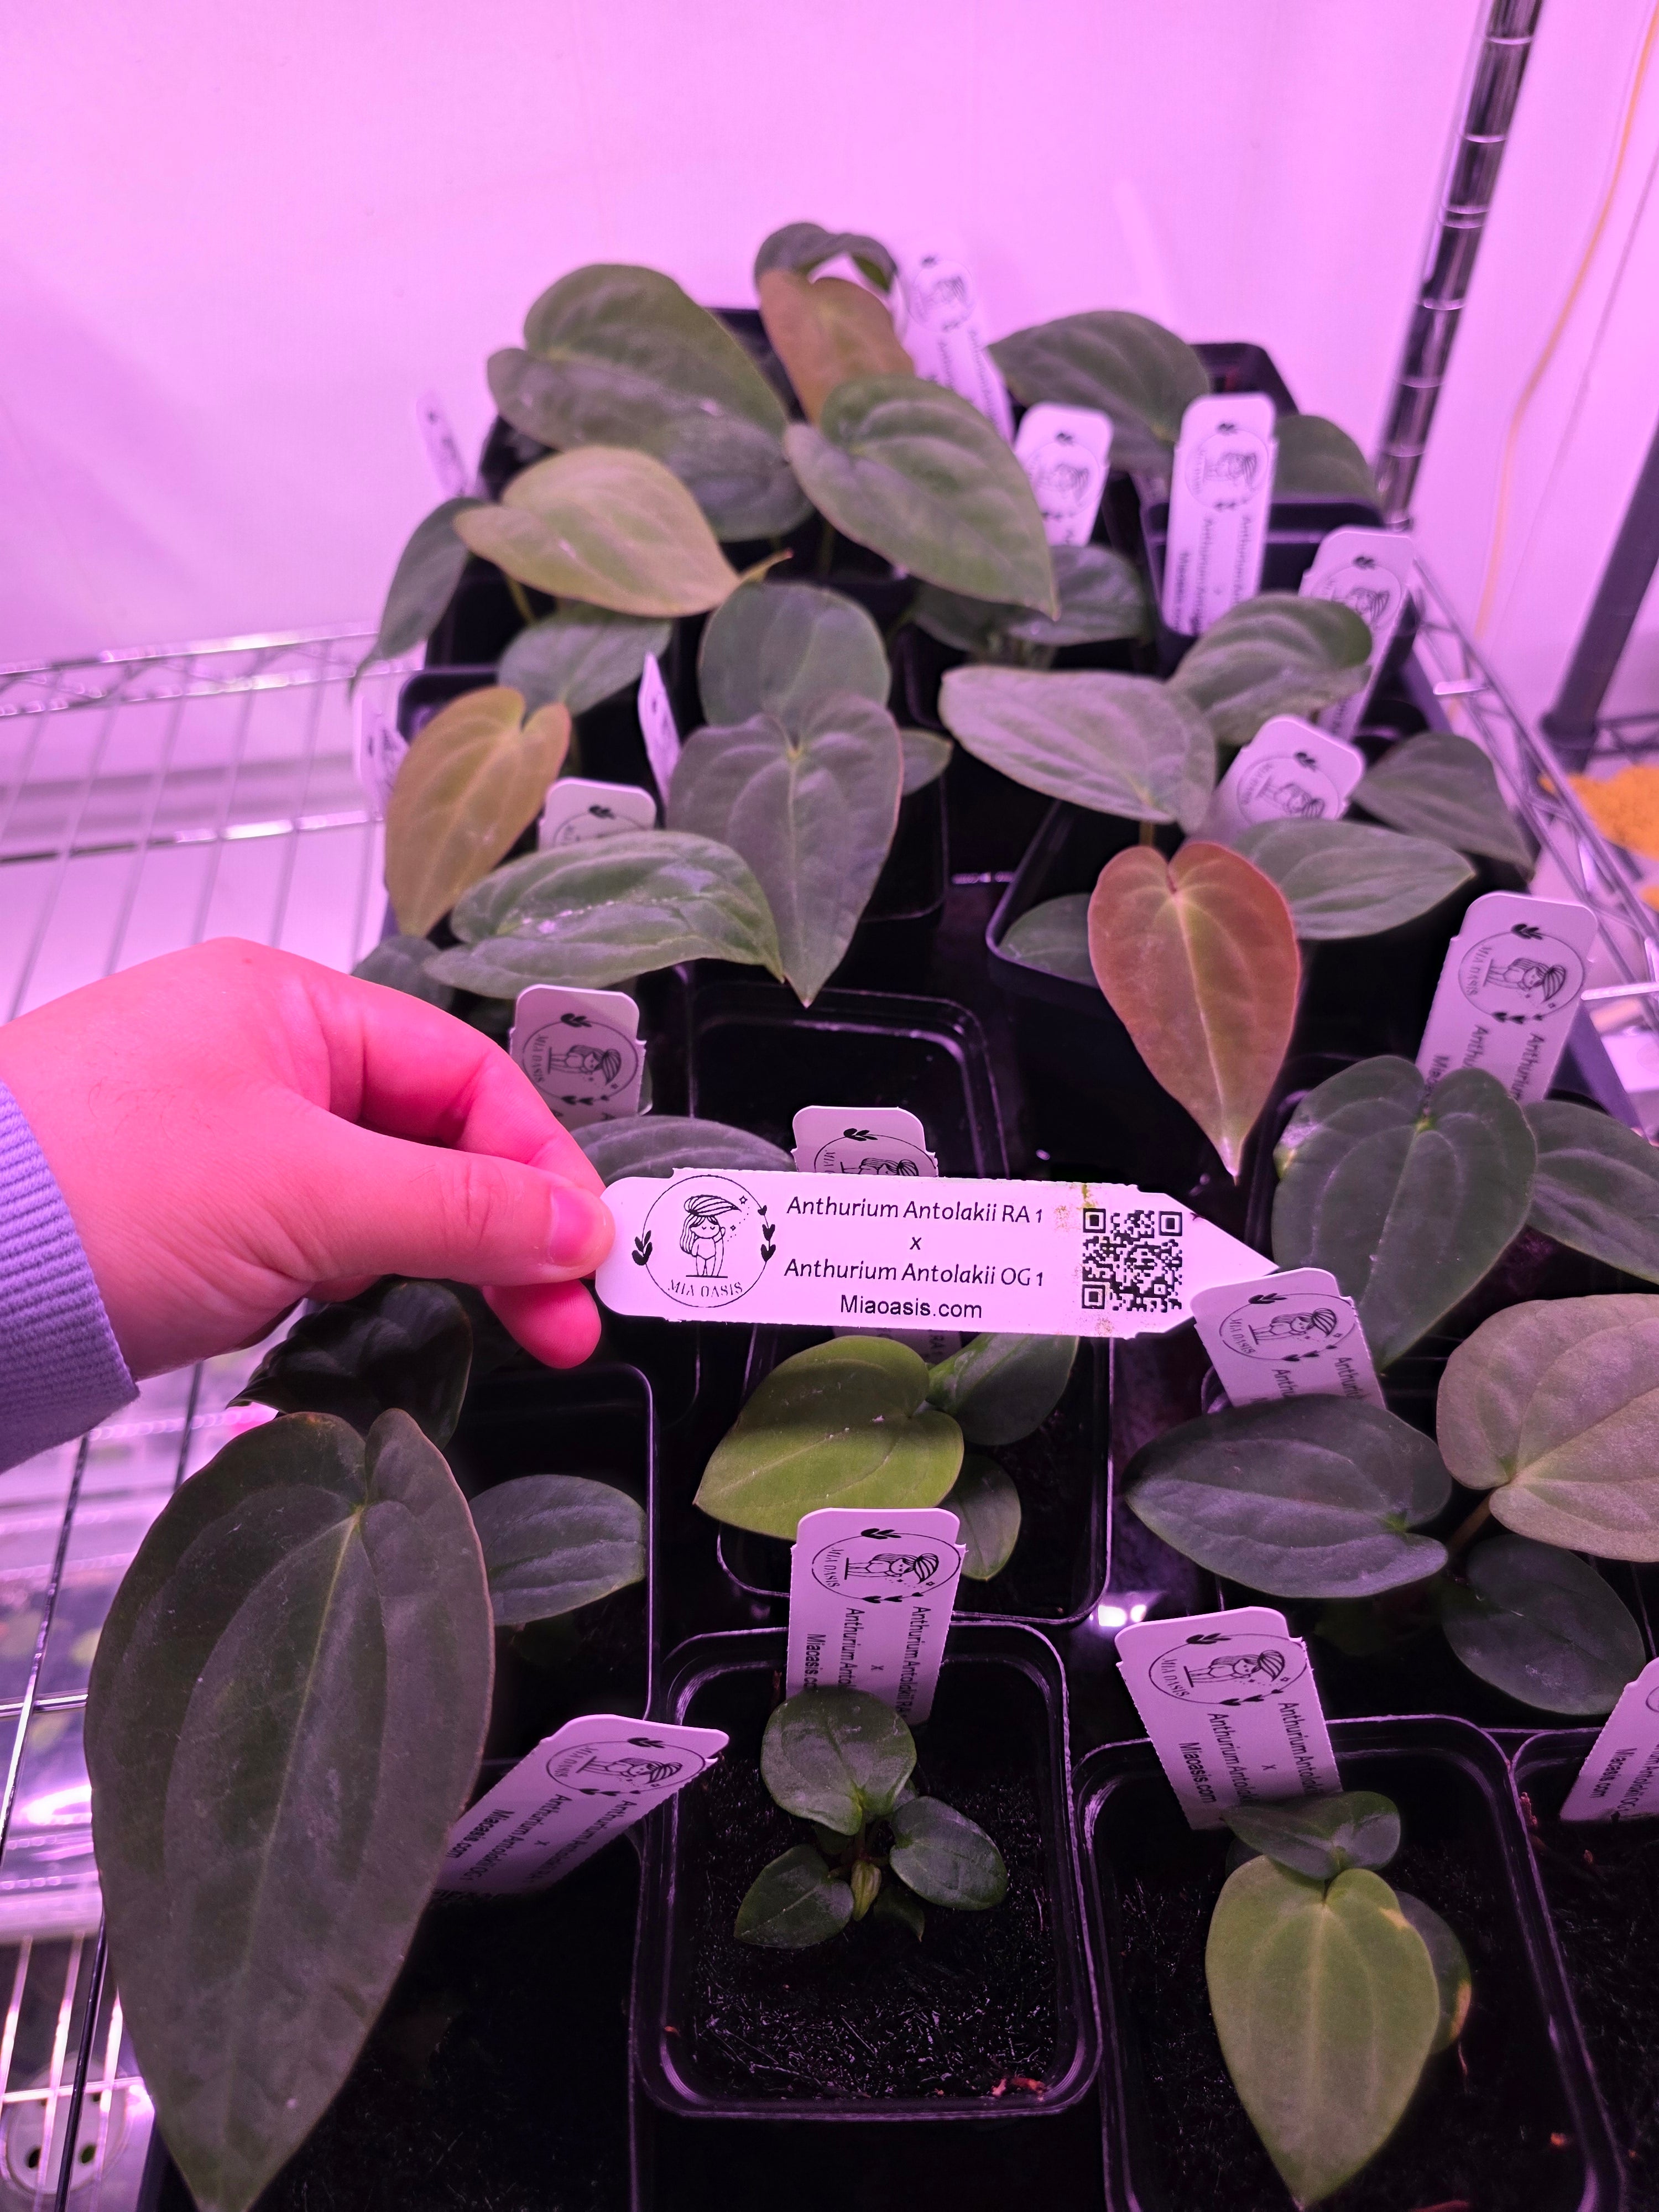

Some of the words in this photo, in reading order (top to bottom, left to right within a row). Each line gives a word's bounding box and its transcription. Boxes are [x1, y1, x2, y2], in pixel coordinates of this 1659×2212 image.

[786, 1196, 898, 1218] Anthurium
[903, 1201, 997, 1221] Antolakii
[1002, 1205, 1030, 1223] RA
[1036, 1209, 1042, 1223] 1
[668, 1279, 694, 1296] MIA
[701, 1282, 743, 1297] OASIS
[784, 1259, 896, 1280] Anthurium
[901, 1262, 995, 1284] Antolakii
[1001, 1267, 1030, 1286] OG
[1036, 1272, 1043, 1286] 1
[841, 1295, 982, 1318] Miaoasis.com
[840, 1608, 865, 1660] Anthurium
[904, 1606, 931, 1660] Anthurium
[804, 1634, 826, 1688] Miaoasis.co
[1207, 1713, 1241, 1766] Anthurium
[1278, 1702, 1307, 1756] Anthurium
[1178, 1742, 1217, 1803] Miaoasis.com
[445, 1809, 515, 1858] Miaoasis.com
[511, 1793, 573, 1836] Anthurium
